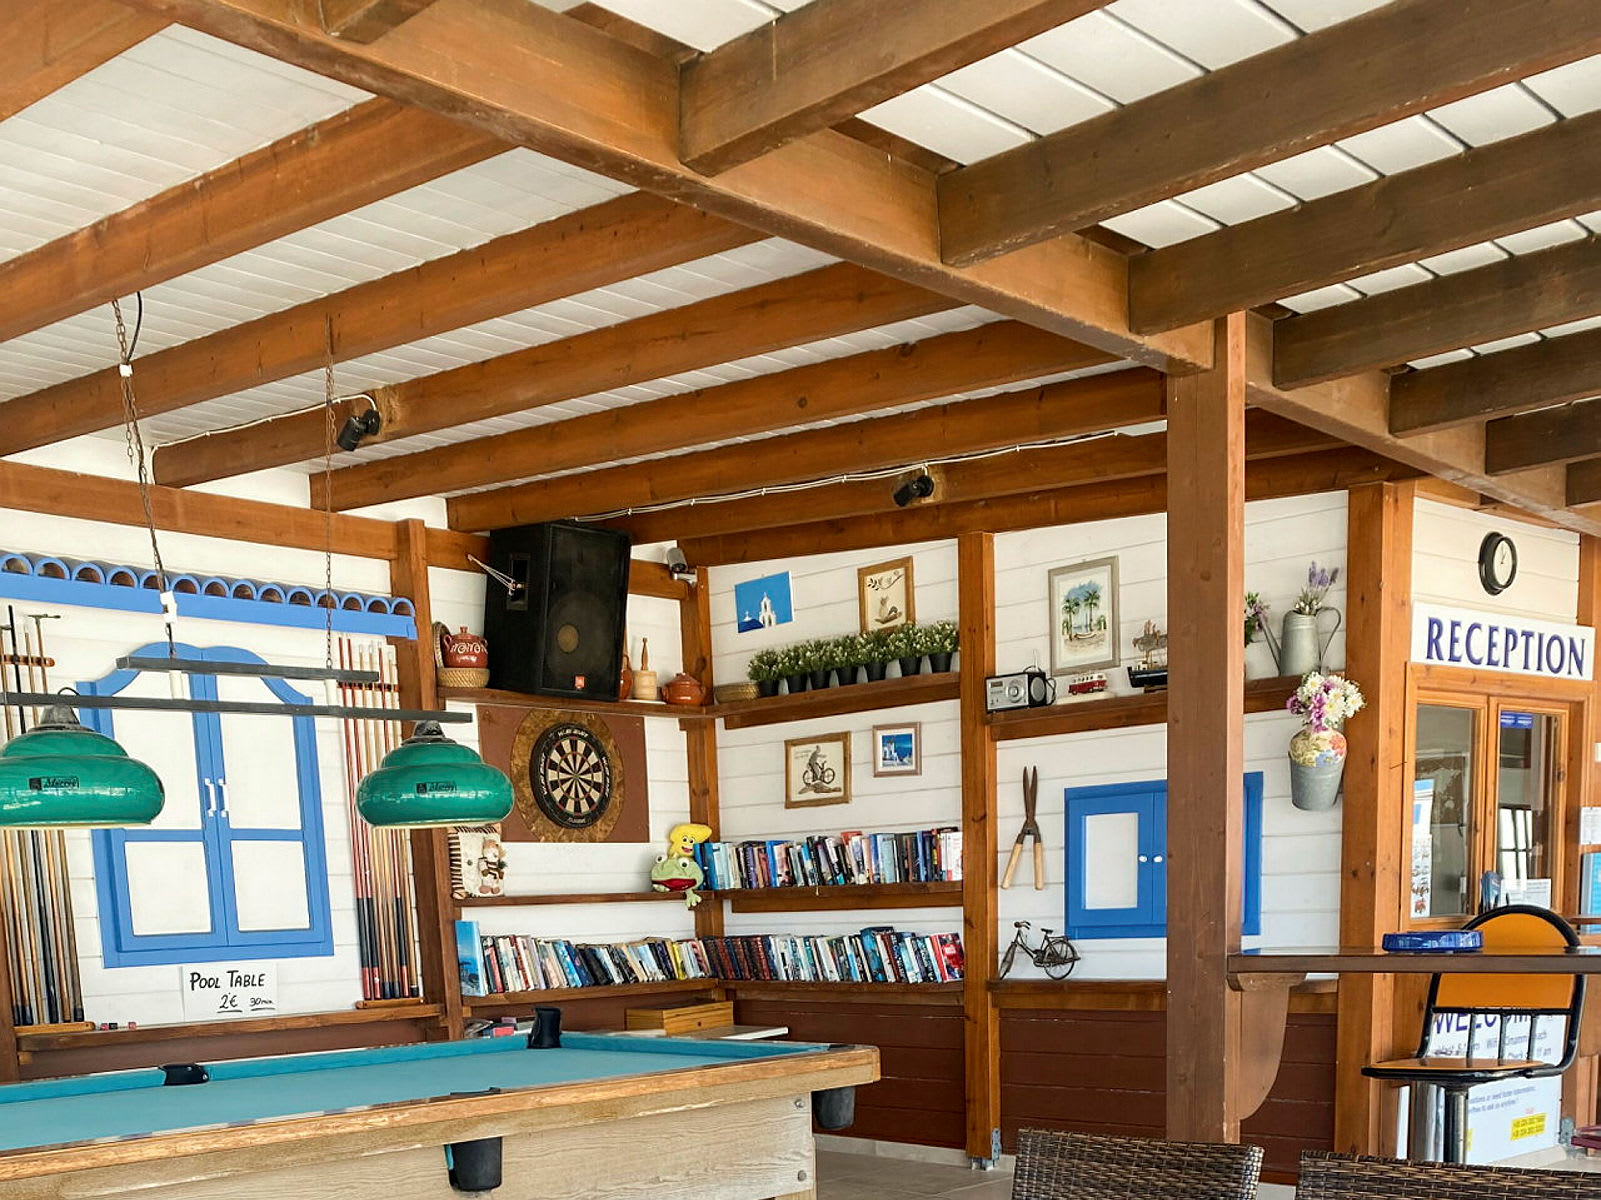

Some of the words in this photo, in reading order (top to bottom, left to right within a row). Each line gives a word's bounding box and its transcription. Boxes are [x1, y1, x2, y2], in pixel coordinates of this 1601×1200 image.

[1426, 616, 1586, 677] RECEPTION
[190, 971, 221, 991] POOL
[226, 970, 266, 988] TABLE
